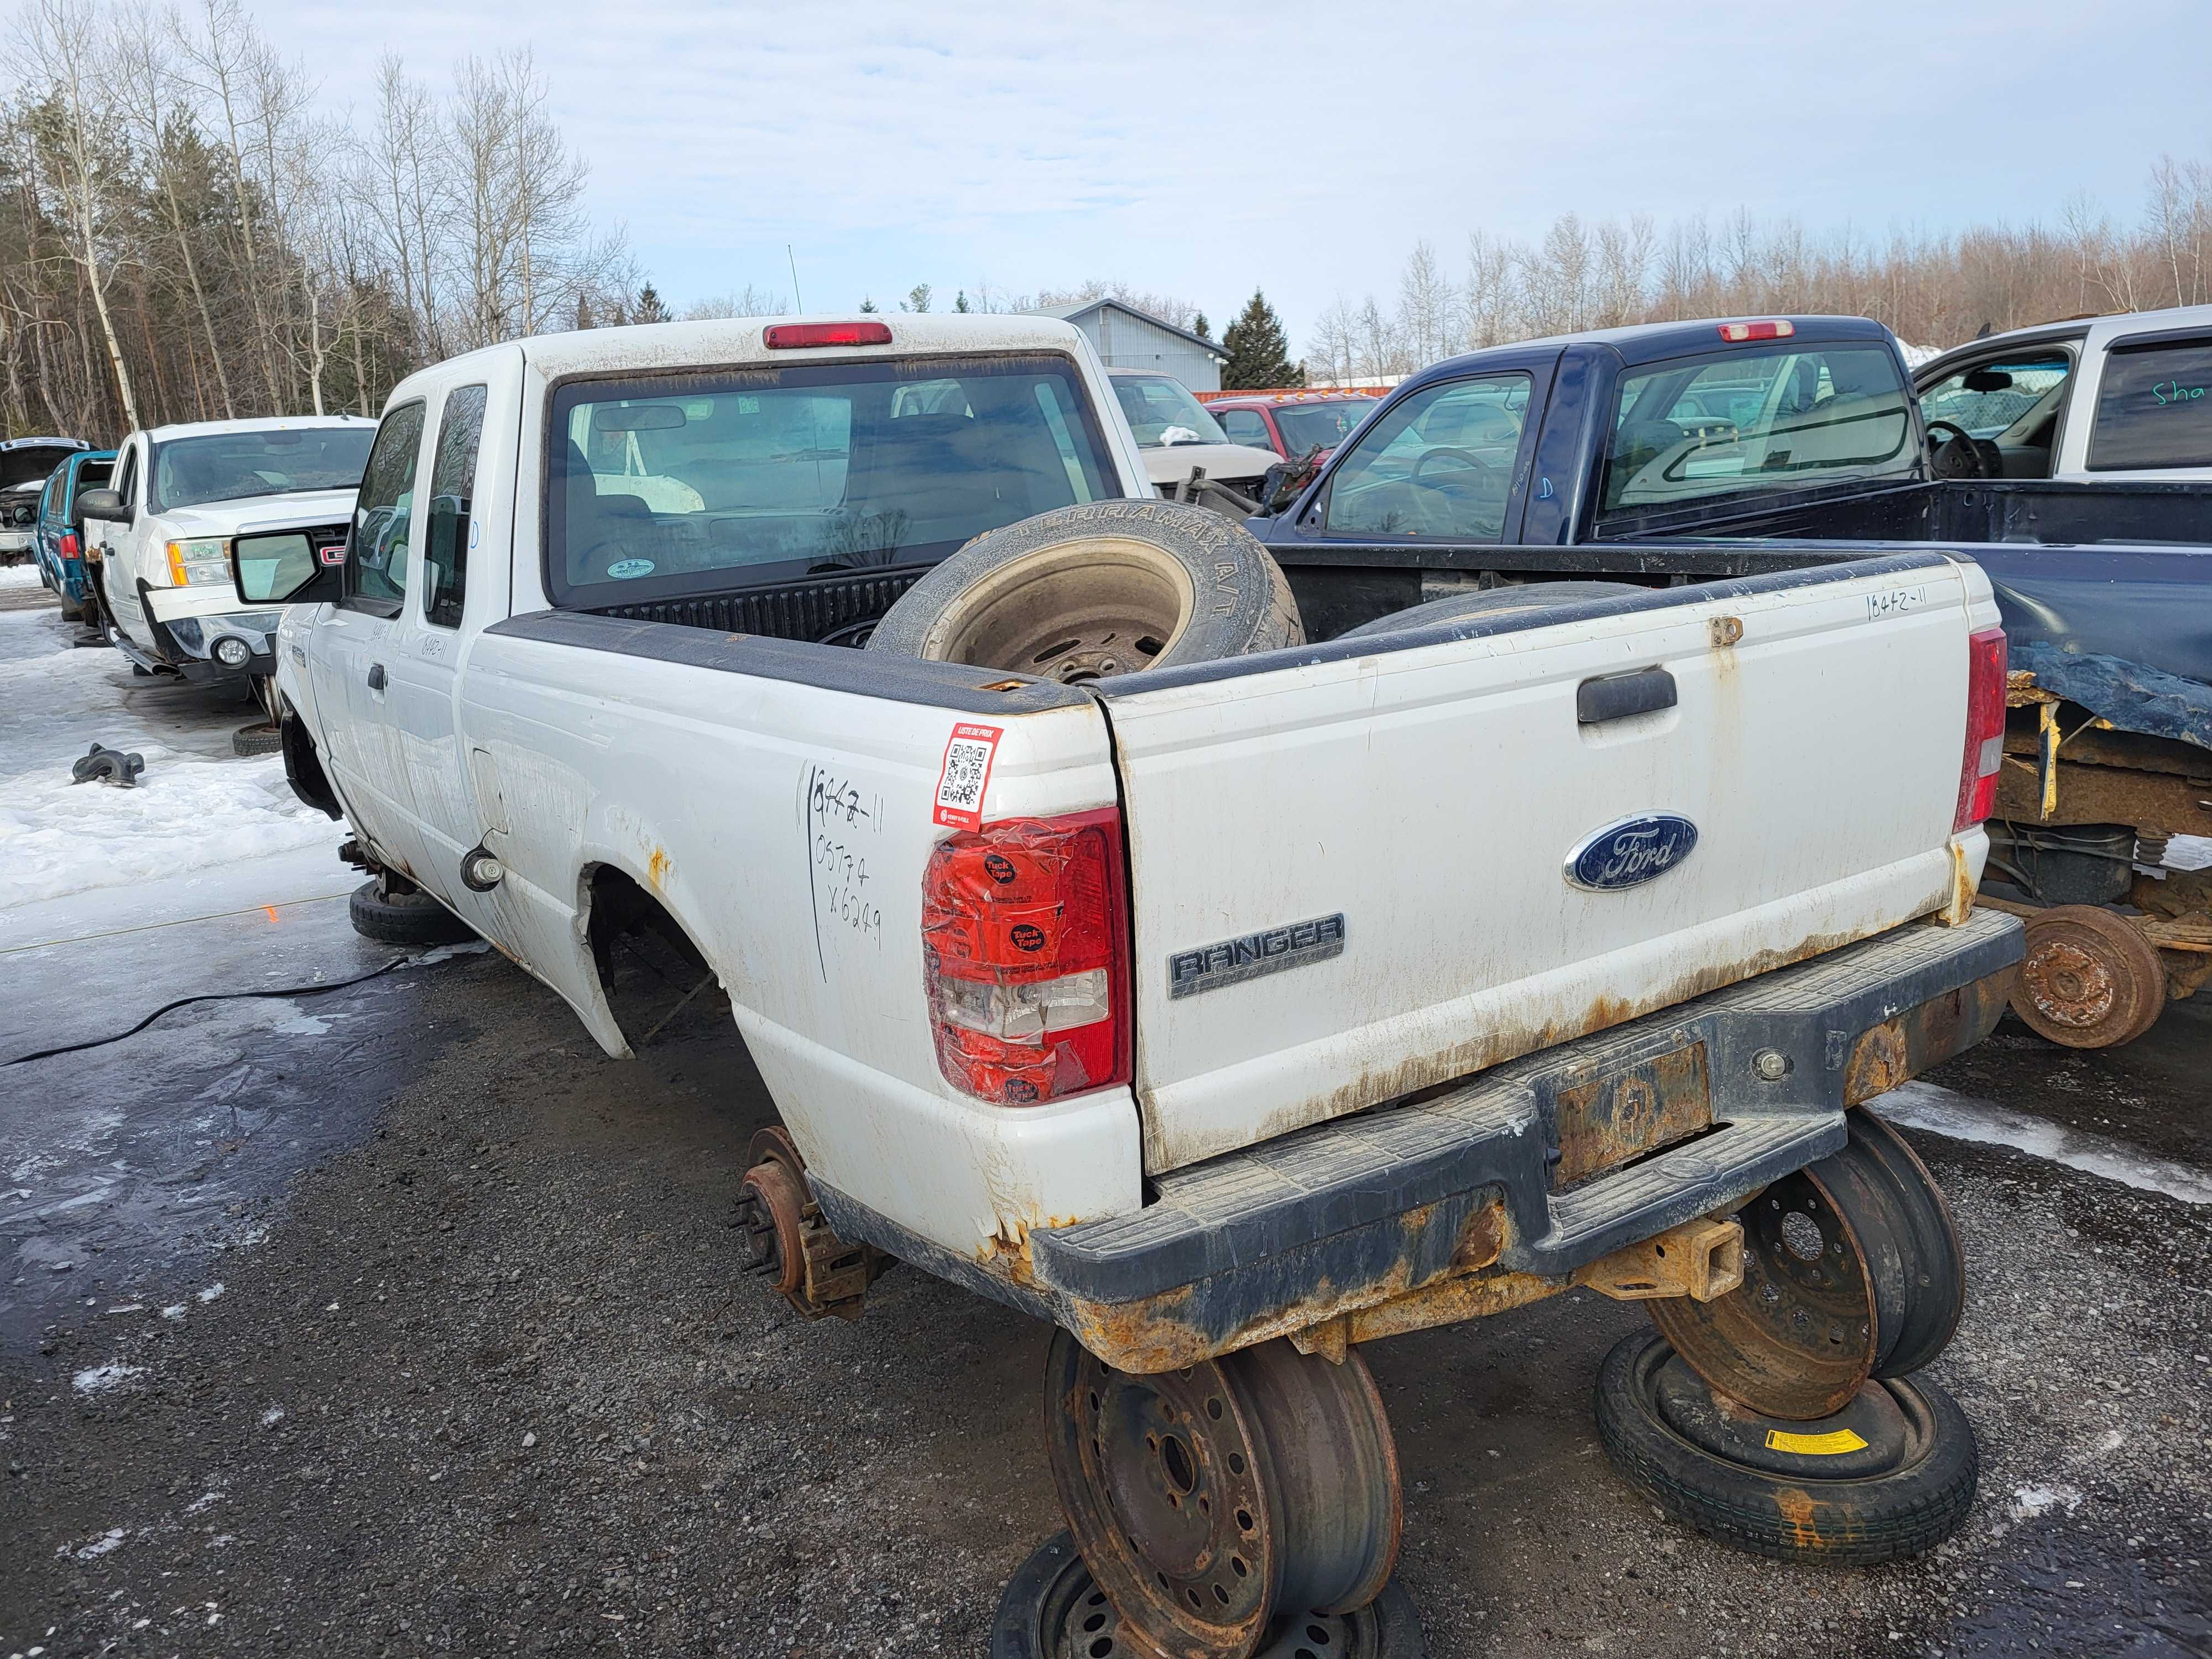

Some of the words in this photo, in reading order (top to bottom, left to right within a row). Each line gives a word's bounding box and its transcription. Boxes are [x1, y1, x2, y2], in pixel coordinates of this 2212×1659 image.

[1540, 477, 1553, 498] D
[1009, 504, 1228, 555] TERRAMAX
[1214, 562, 1239, 617] A/T
[1866, 586, 1927, 621] 18442-11
[958, 726, 973, 735] LISTE
[979, 729, 994, 738] PRIX
[1605, 828, 1677, 878] Ford
[987, 861, 1009, 870] Tuck
[990, 870, 1013, 879] Tape
[1013, 931, 1039, 940] Tuck
[1017, 939, 1042, 948] Tape
[1172, 916, 1343, 983] RANGER
